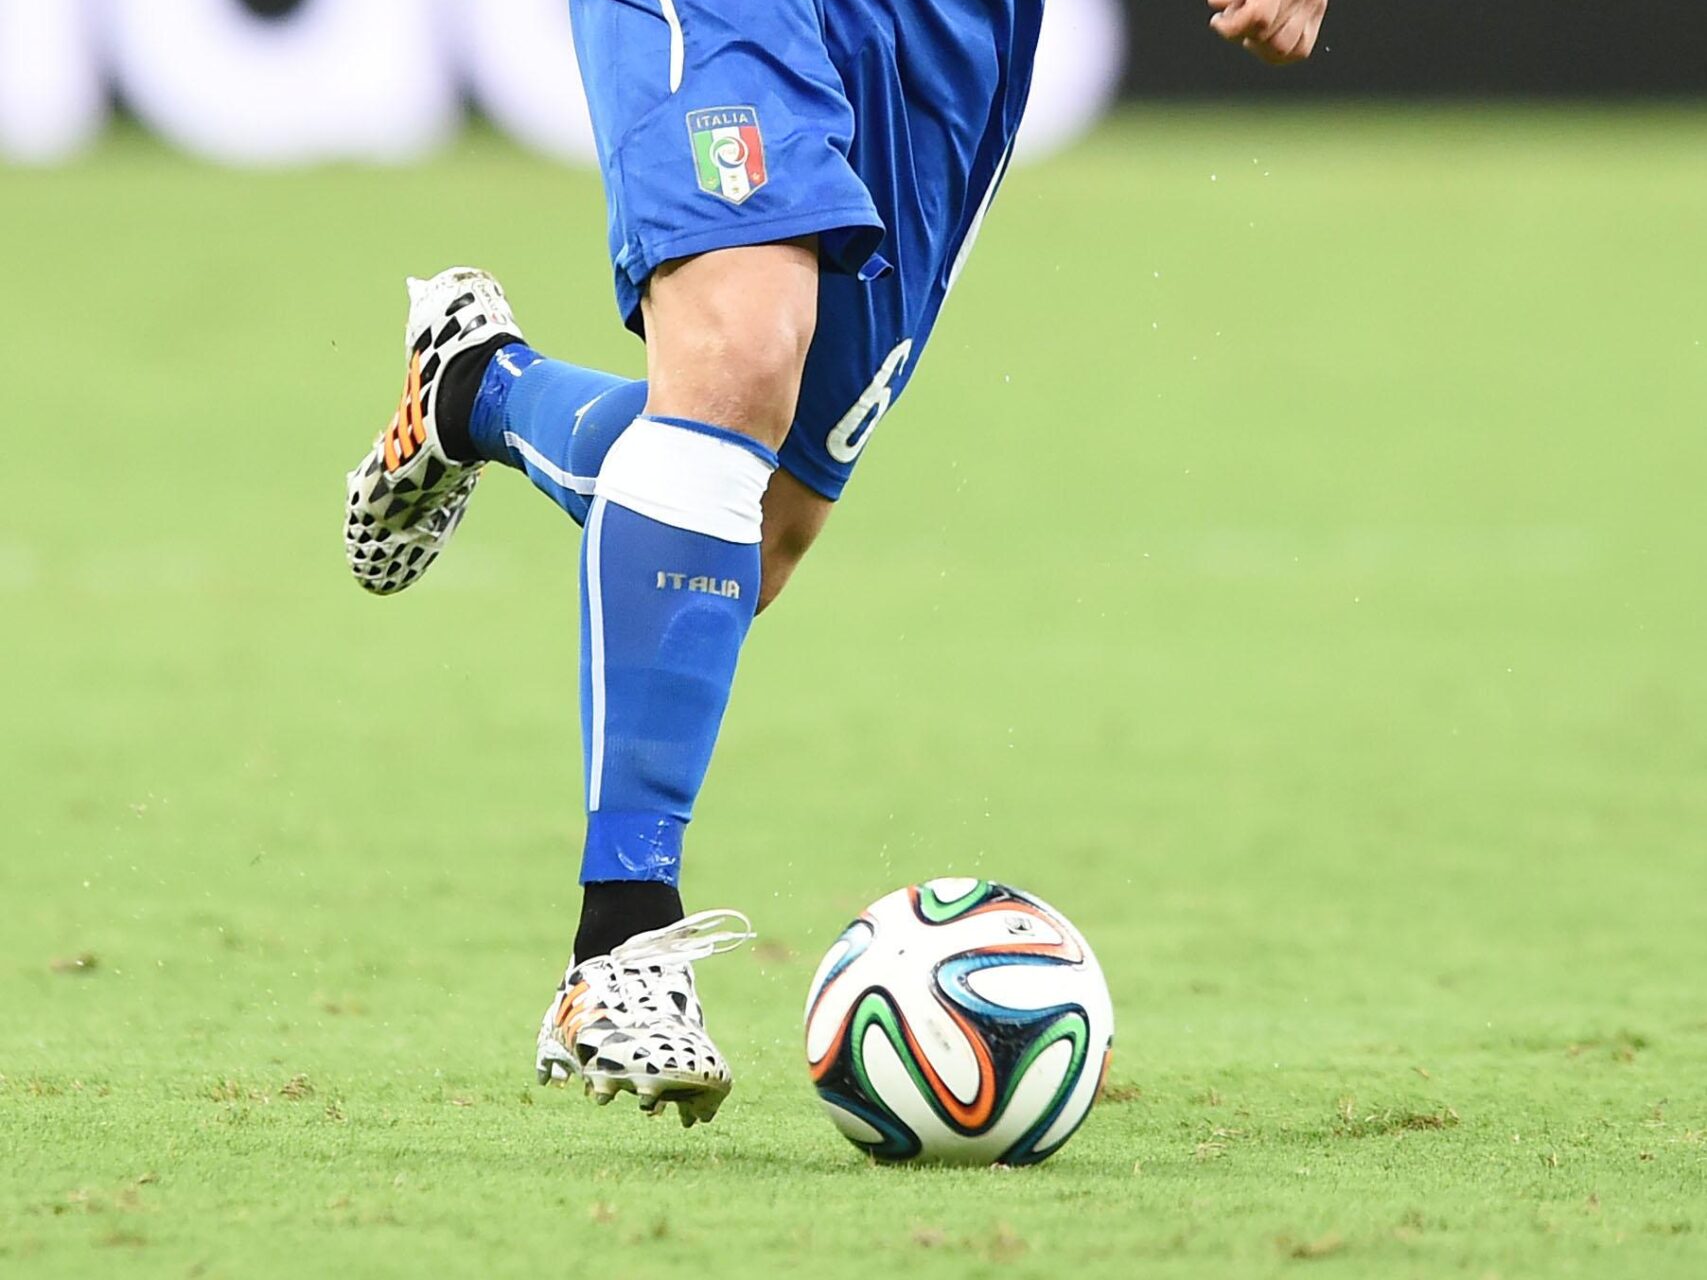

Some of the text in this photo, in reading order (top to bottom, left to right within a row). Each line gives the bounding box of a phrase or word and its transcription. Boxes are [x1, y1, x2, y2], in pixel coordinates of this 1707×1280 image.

[696, 112, 749, 129] ITALIA
[826, 338, 913, 464] 6
[656, 571, 740, 599] ITALIA
